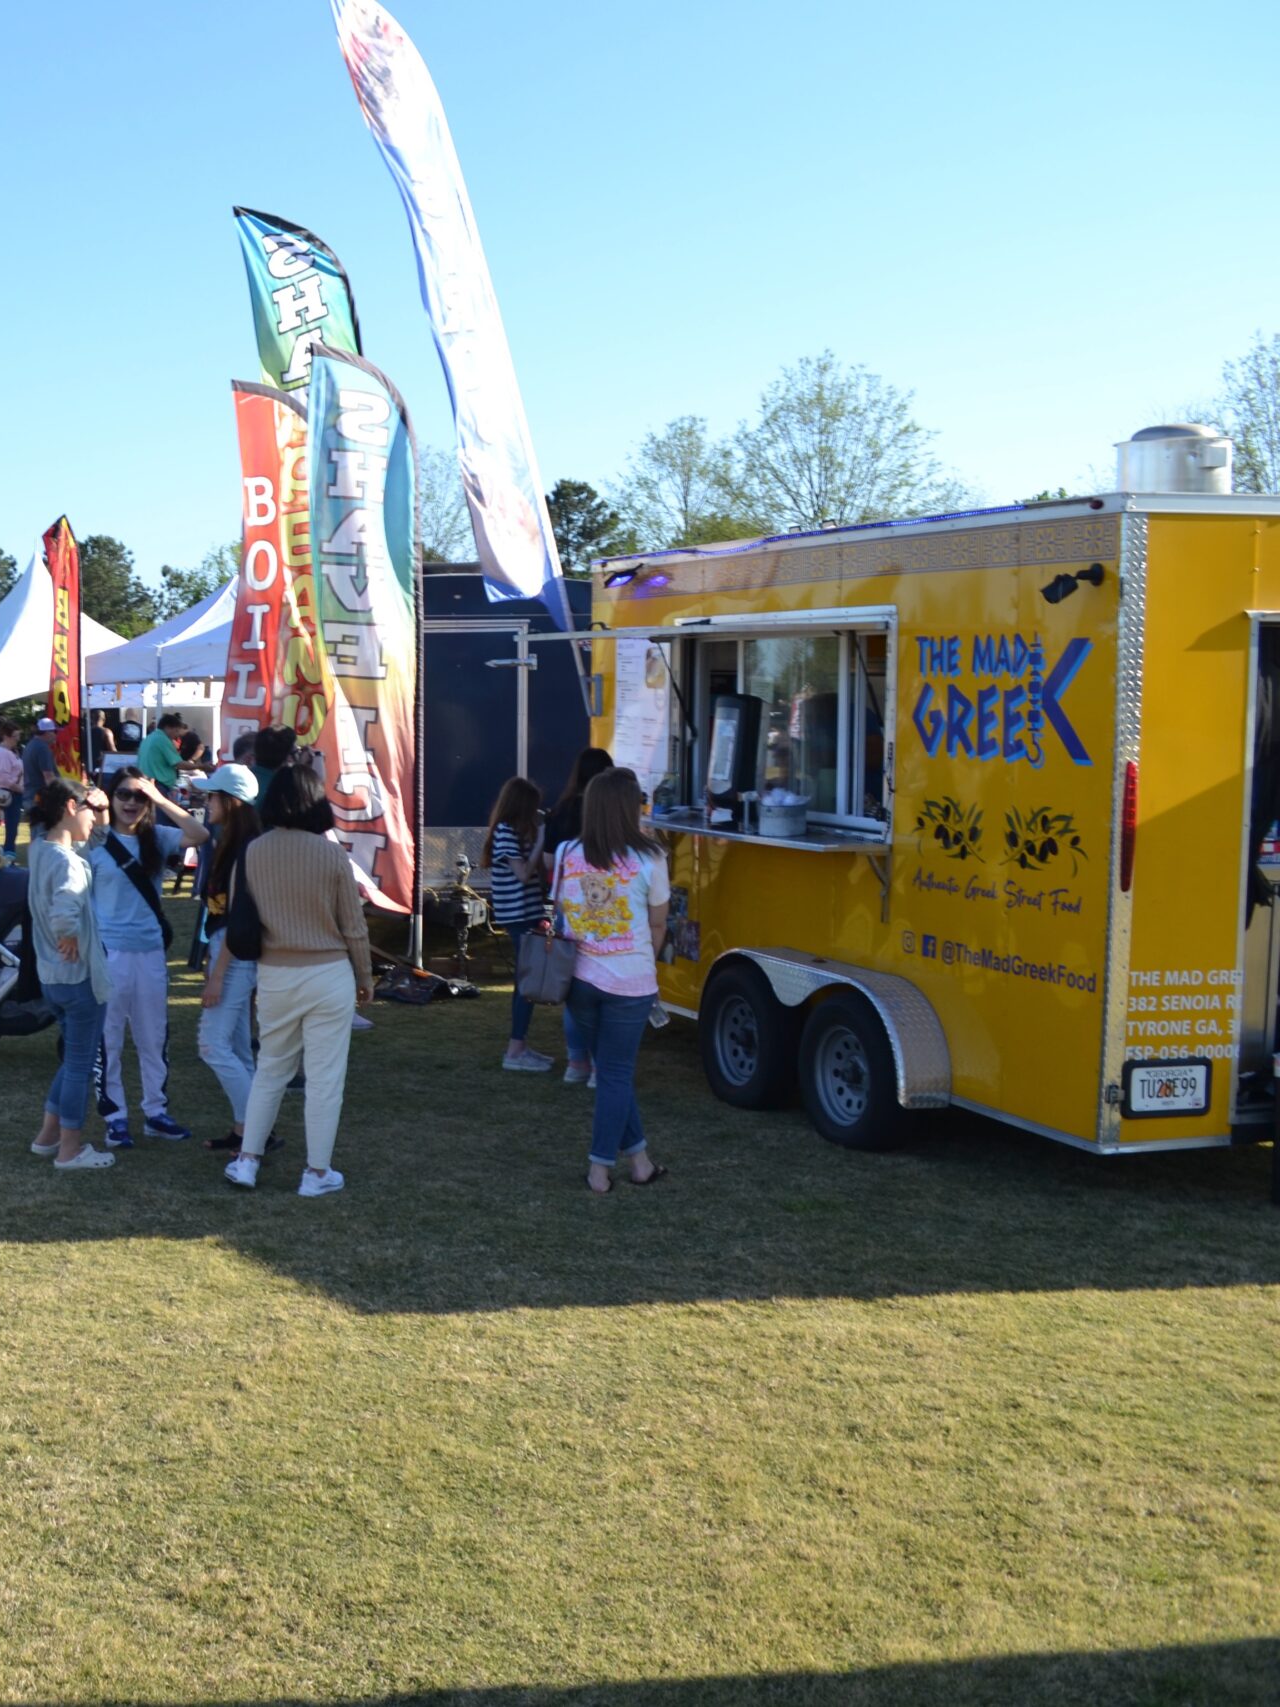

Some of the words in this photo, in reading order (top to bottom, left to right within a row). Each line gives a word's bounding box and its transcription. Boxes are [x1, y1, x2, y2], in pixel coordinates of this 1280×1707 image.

[915, 634, 962, 678] THE
[971, 633, 1031, 679] MAD
[912, 636, 1095, 767] GREEK
[913, 867, 961, 896] Authentic
[964, 874, 997, 901] Greek
[1003, 879, 1045, 911] Street
[1049, 888, 1083, 916] Food
[941, 940, 1097, 993] @TheMadGreekFood
[1130, 970, 1161, 987] THE
[1164, 969, 1204, 986] MAD
[1128, 995, 1158, 1012] 382
[1161, 994, 1221, 1011] SENOIA
[1126, 1020, 1191, 1037] TYRONE
[1195, 1019, 1223, 1037] GA,
